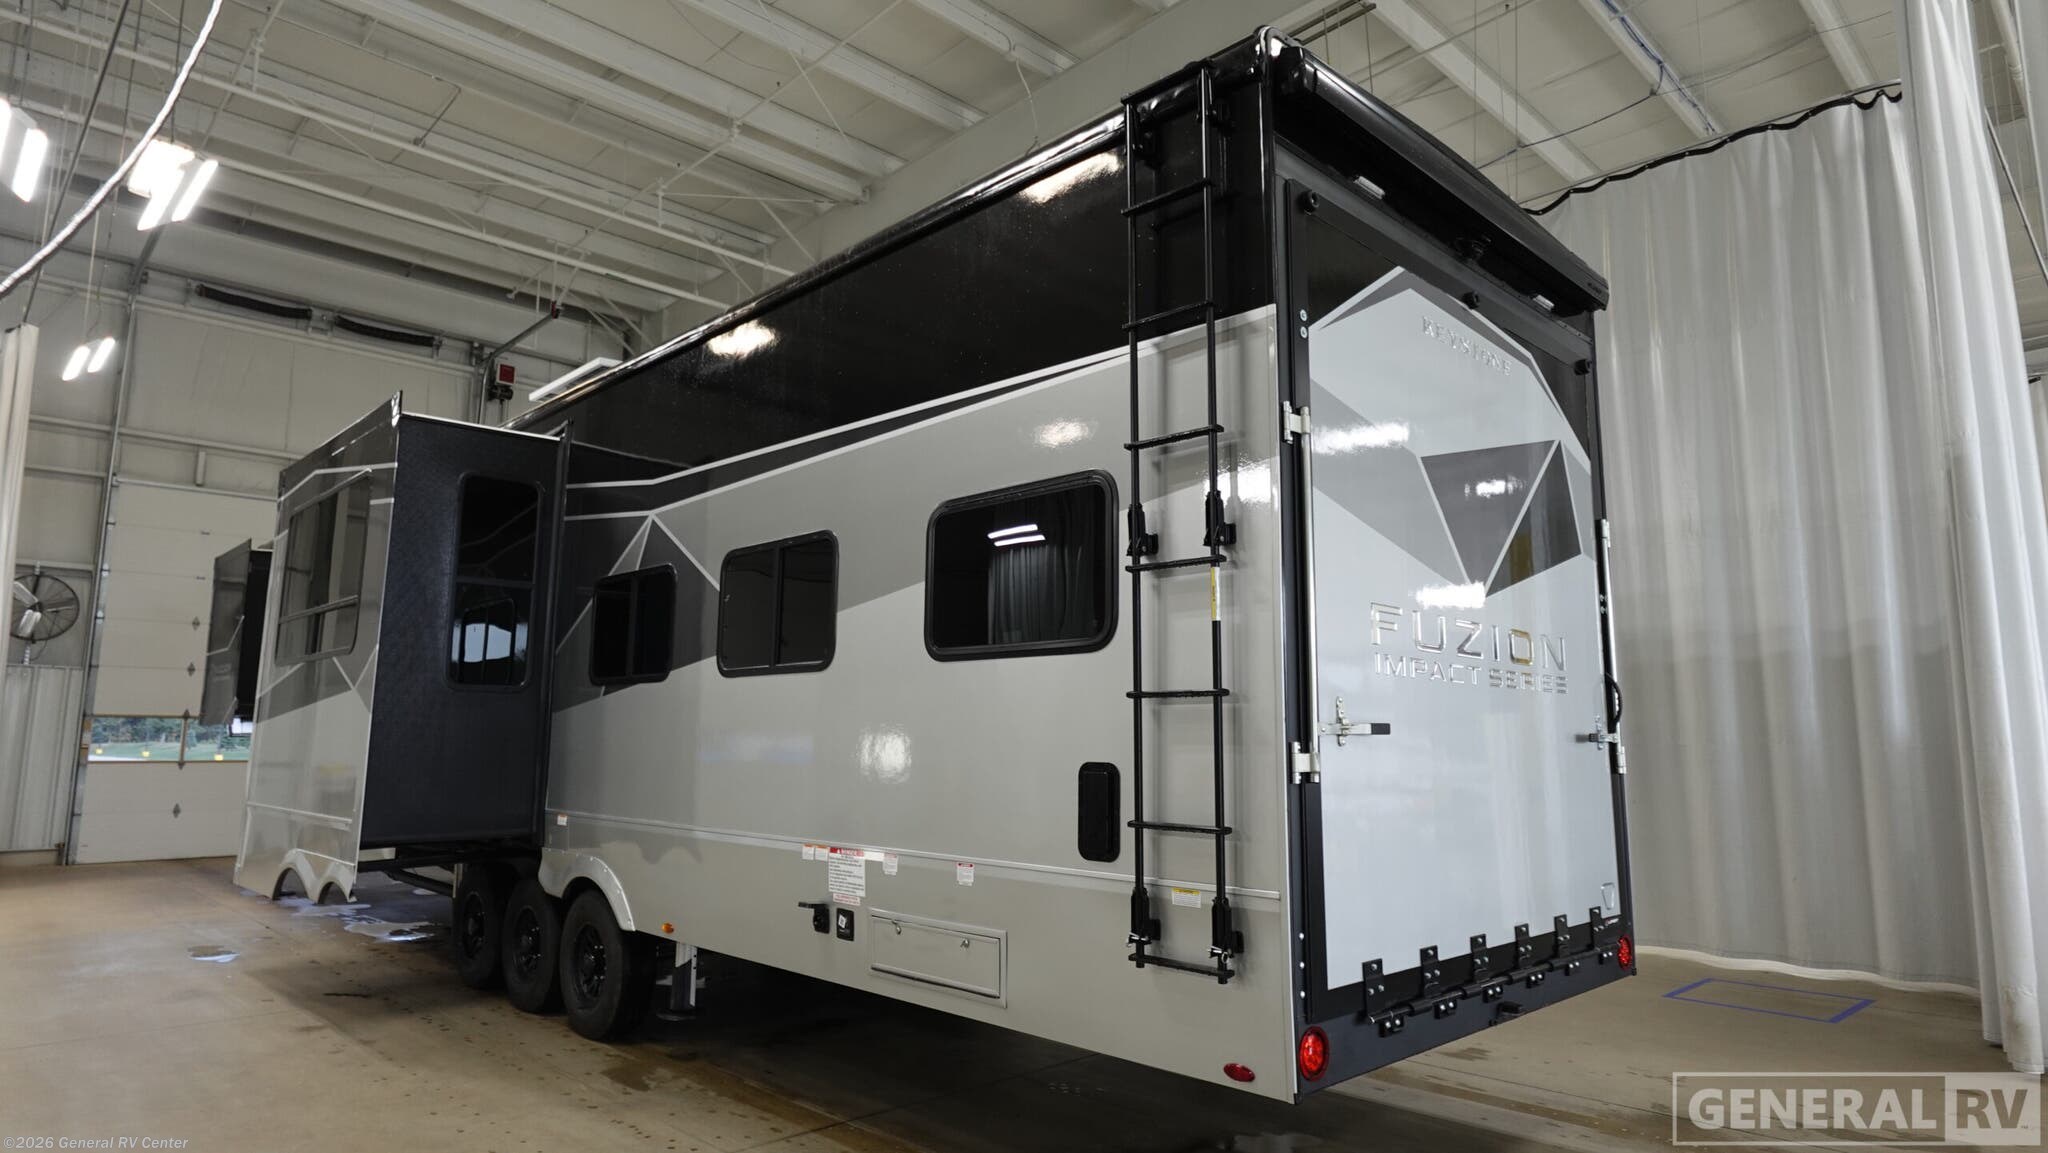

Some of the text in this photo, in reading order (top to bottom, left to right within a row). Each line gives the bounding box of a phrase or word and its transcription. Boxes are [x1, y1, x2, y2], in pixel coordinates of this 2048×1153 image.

[1423, 316, 1512, 377] KEYSTONE
[1370, 602, 1568, 671] FUZION
[1374, 652, 1568, 695] IMPACT SERIES
